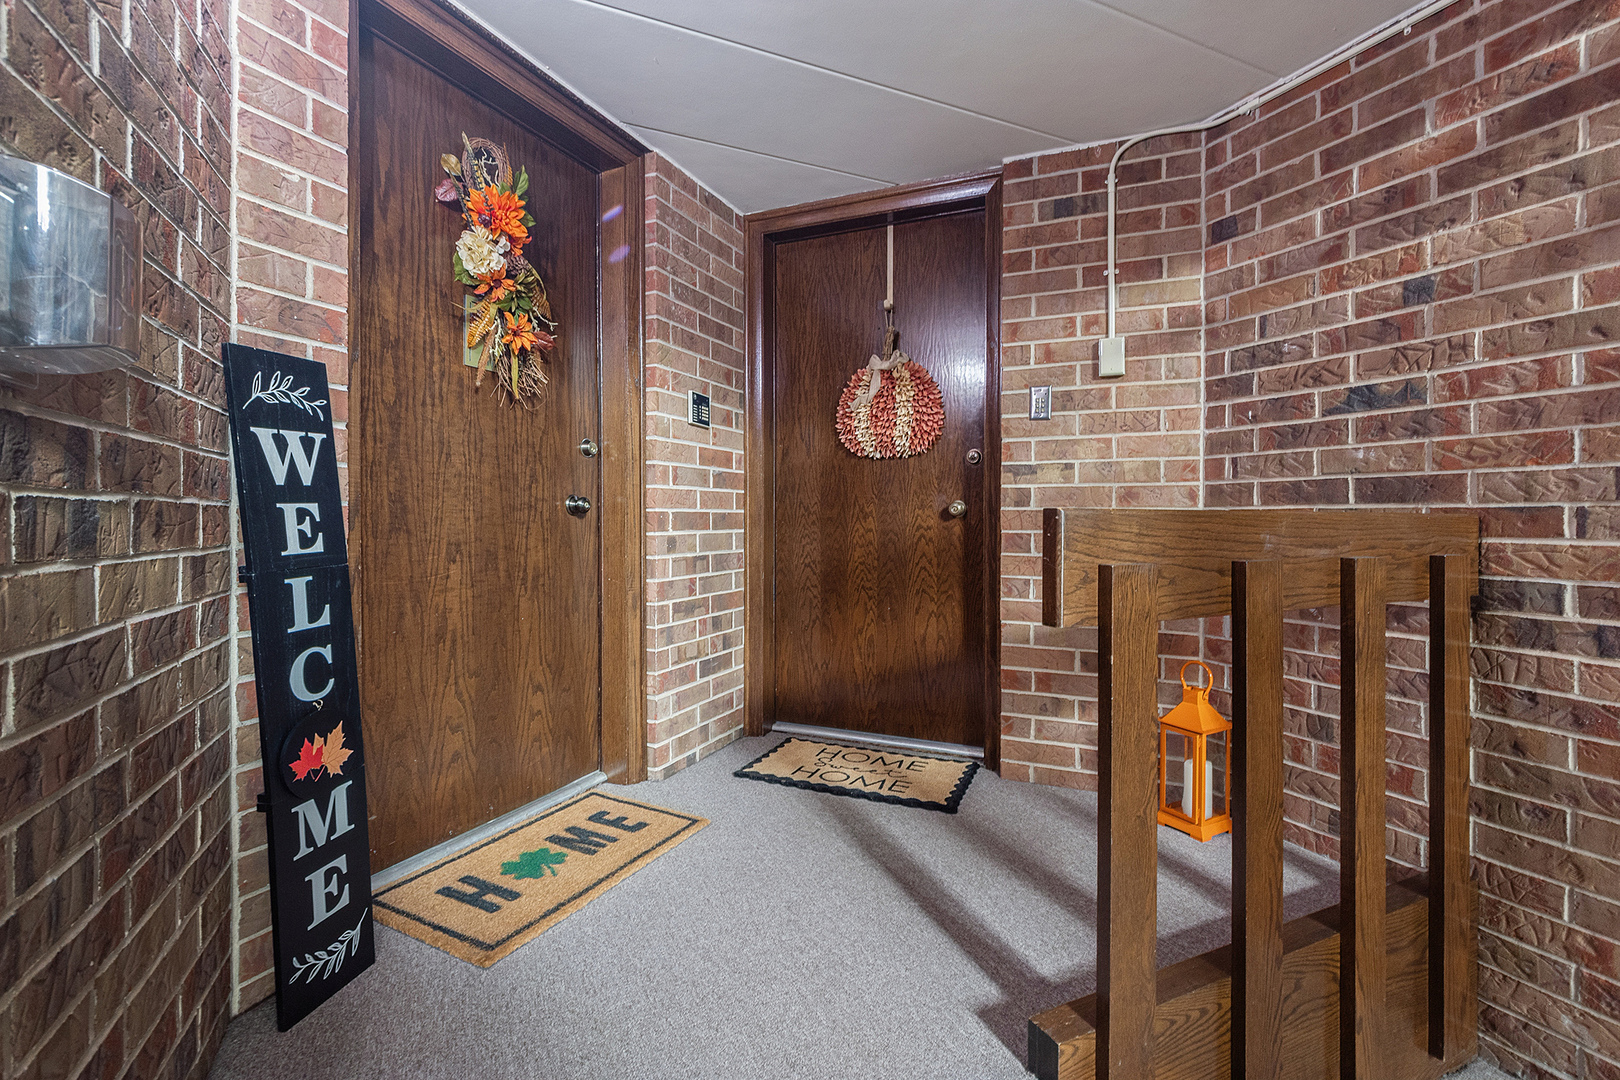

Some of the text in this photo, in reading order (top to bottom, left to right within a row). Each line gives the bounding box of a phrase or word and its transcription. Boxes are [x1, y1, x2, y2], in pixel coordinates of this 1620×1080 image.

[250, 426, 354, 931] WELCME
[791, 765, 913, 794] HOME
[816, 747, 929, 773] HOME
[435, 810, 651, 914] HME
